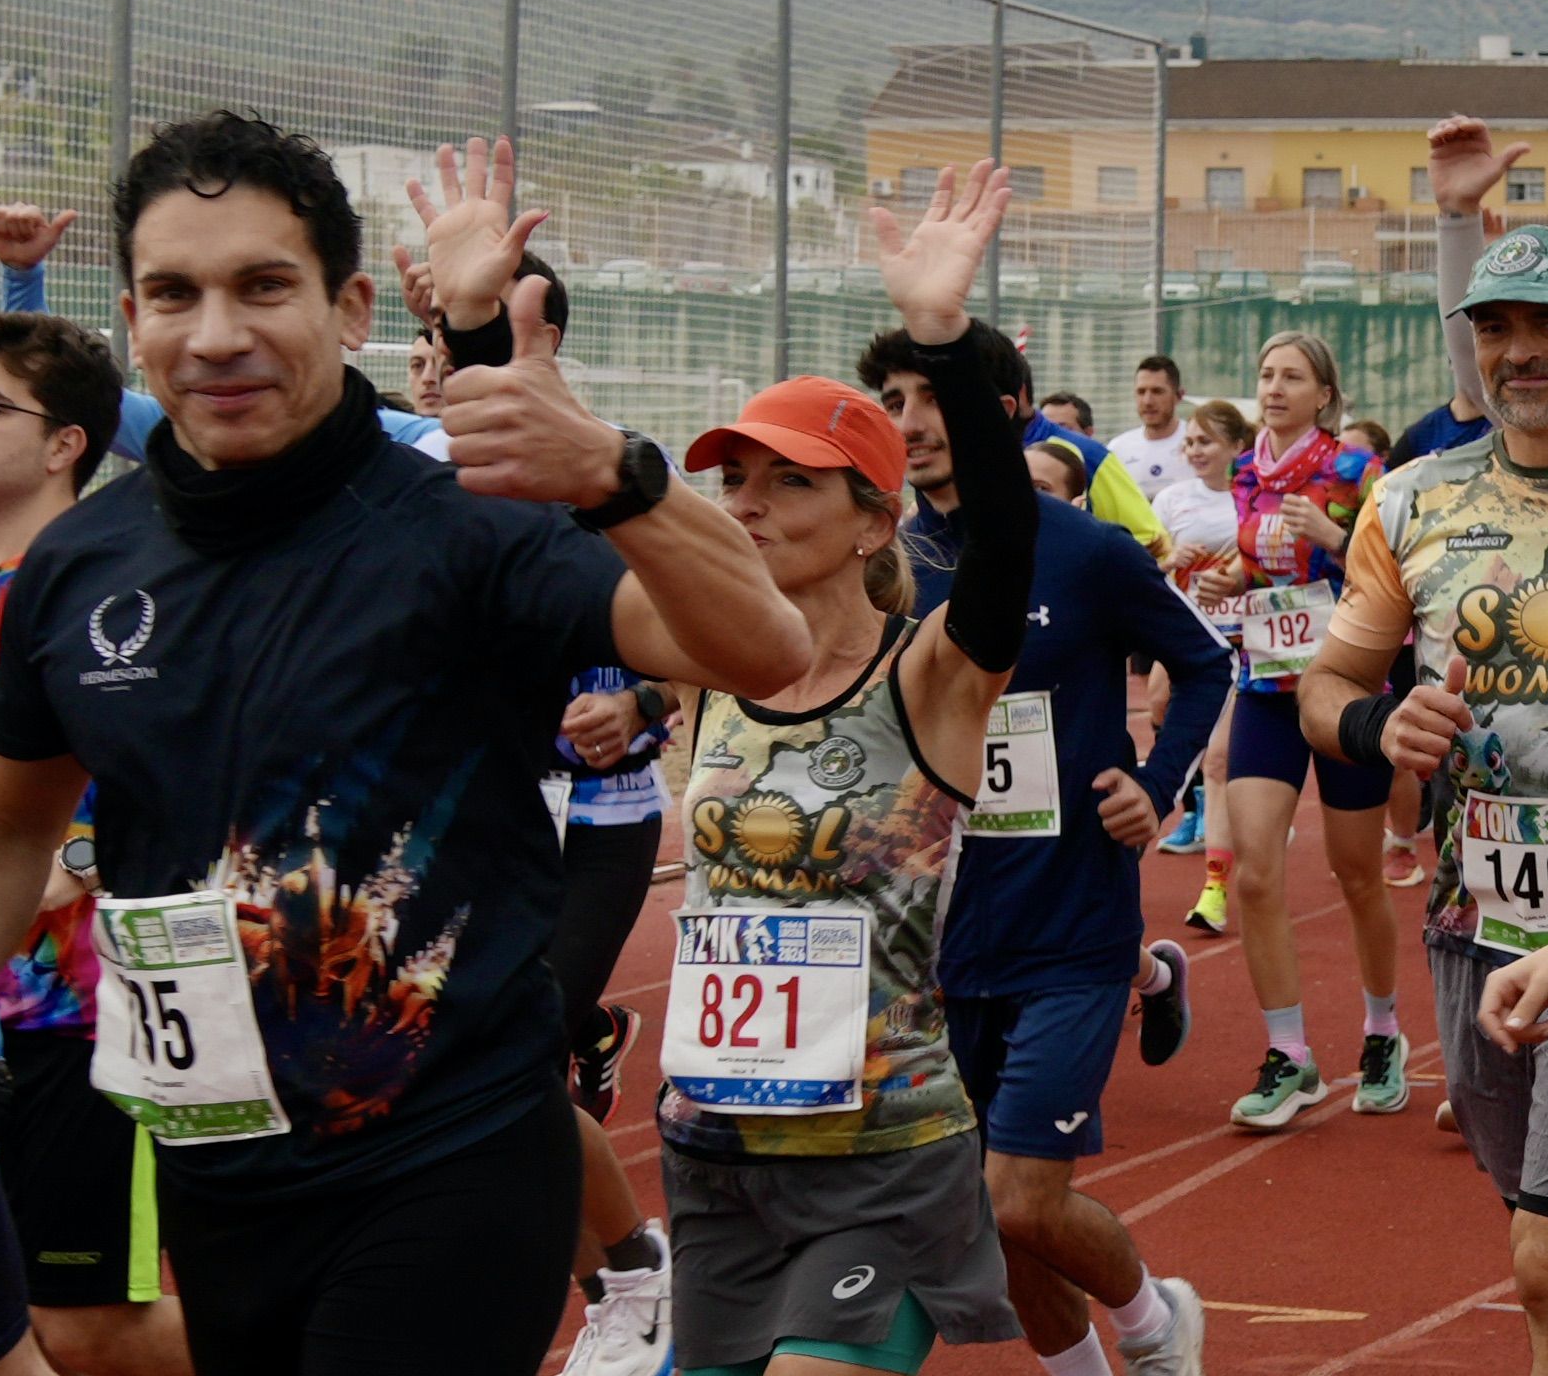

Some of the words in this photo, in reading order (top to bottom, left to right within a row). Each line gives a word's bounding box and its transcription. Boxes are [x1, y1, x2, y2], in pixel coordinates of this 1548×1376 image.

[1448, 535, 1507, 549] TEAMERGY
[1264, 612, 1315, 648] 192
[1473, 801, 1524, 843] 10K
[693, 916, 741, 963] 21K
[699, 973, 800, 1049] 821
